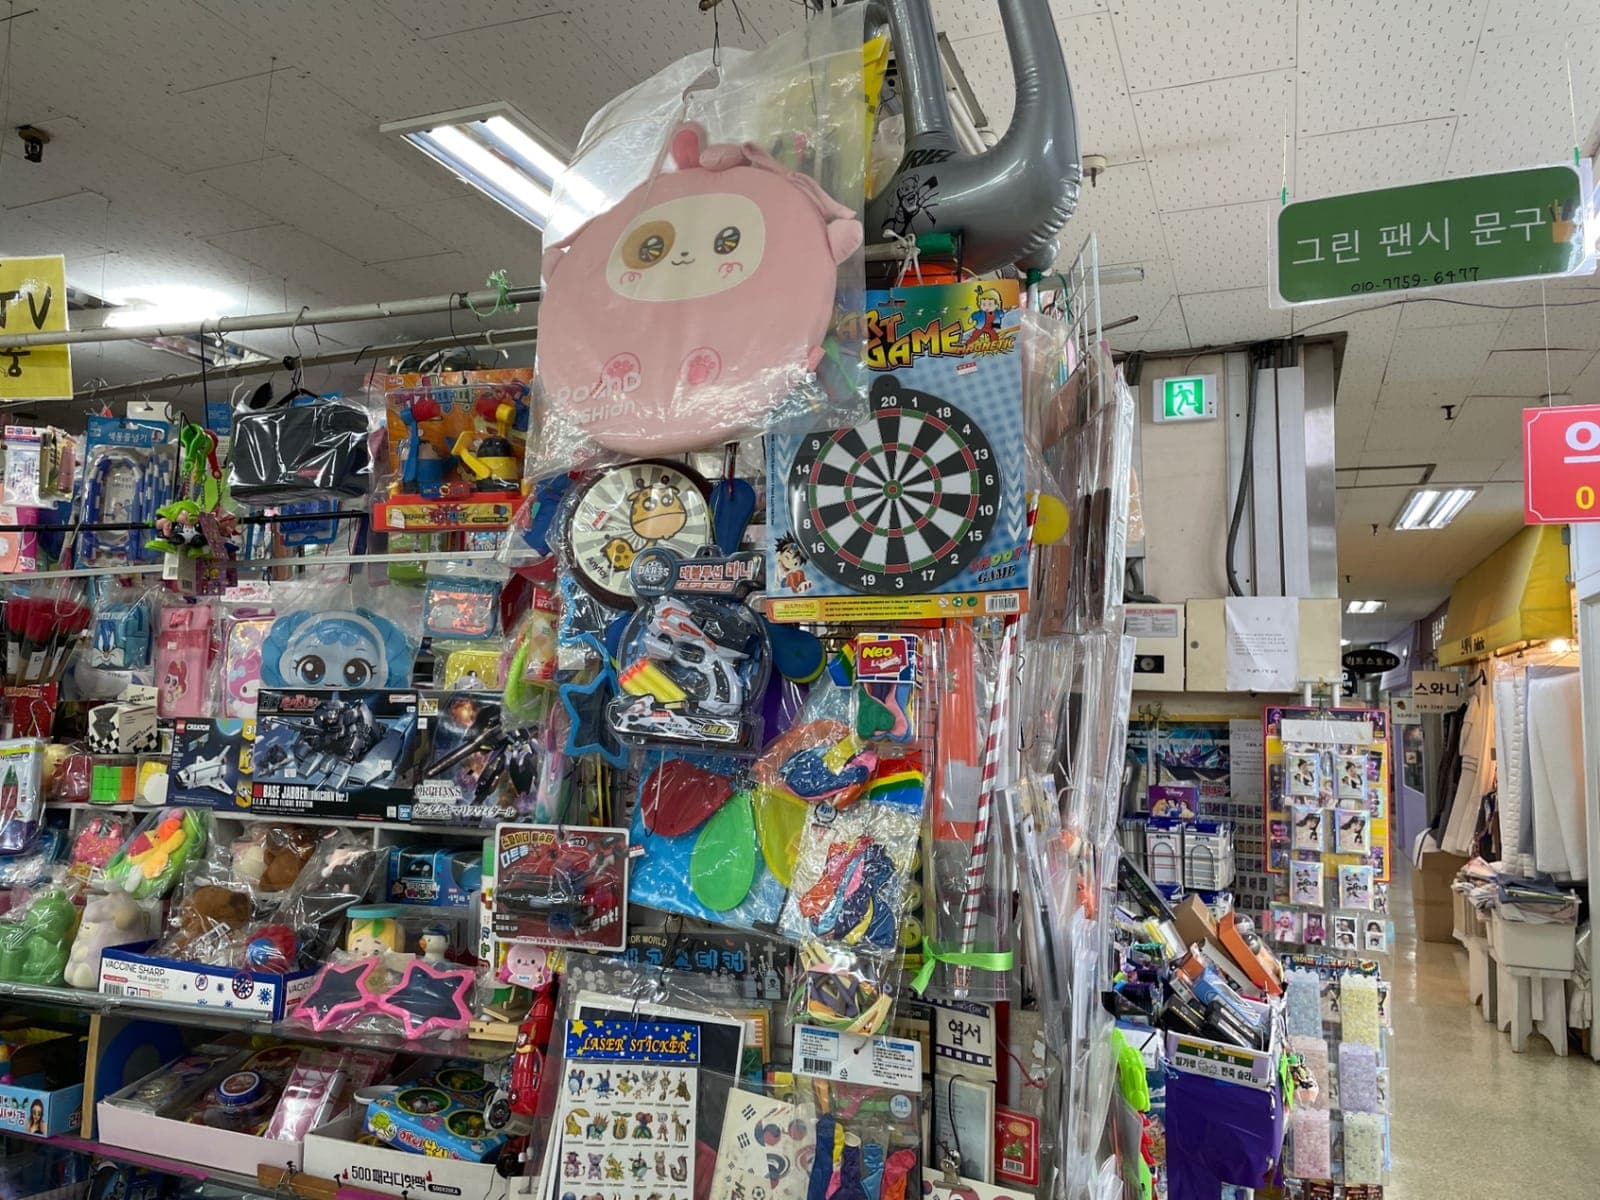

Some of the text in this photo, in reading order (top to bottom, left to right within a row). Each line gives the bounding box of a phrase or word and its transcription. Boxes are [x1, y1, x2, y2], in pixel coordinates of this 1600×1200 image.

[1292, 207, 1547, 264] 그린 팬시 문구
[1351, 266, 1479, 293] 010-7759-6477
[862, 318, 963, 371] GAME
[881, 396, 897, 407] 20
[911, 397, 918, 407] 1
[936, 407, 952, 418] 18
[962, 424, 971, 435] 4
[811, 440, 820, 450] 9
[974, 449, 988, 460] 13
[795, 464, 810, 475] 14
[985, 475, 994, 486] 6
[978, 505, 993, 516] 10
[803, 519, 811, 530] 8
[967, 531, 983, 542] 15
[811, 542, 825, 553] 16
[950, 554, 959, 565] 2
[838, 563, 846, 574] 7
[860, 575, 876, 586] 19
[921, 570, 936, 581] 17
[895, 578, 904, 589] 3
[1414, 682, 1459, 697] 스와니
[104, 959, 165, 977] VACCINE SHARP
[948, 1019, 981, 1046] 엽서
[583, 1037, 690, 1054] LASER STICKER
